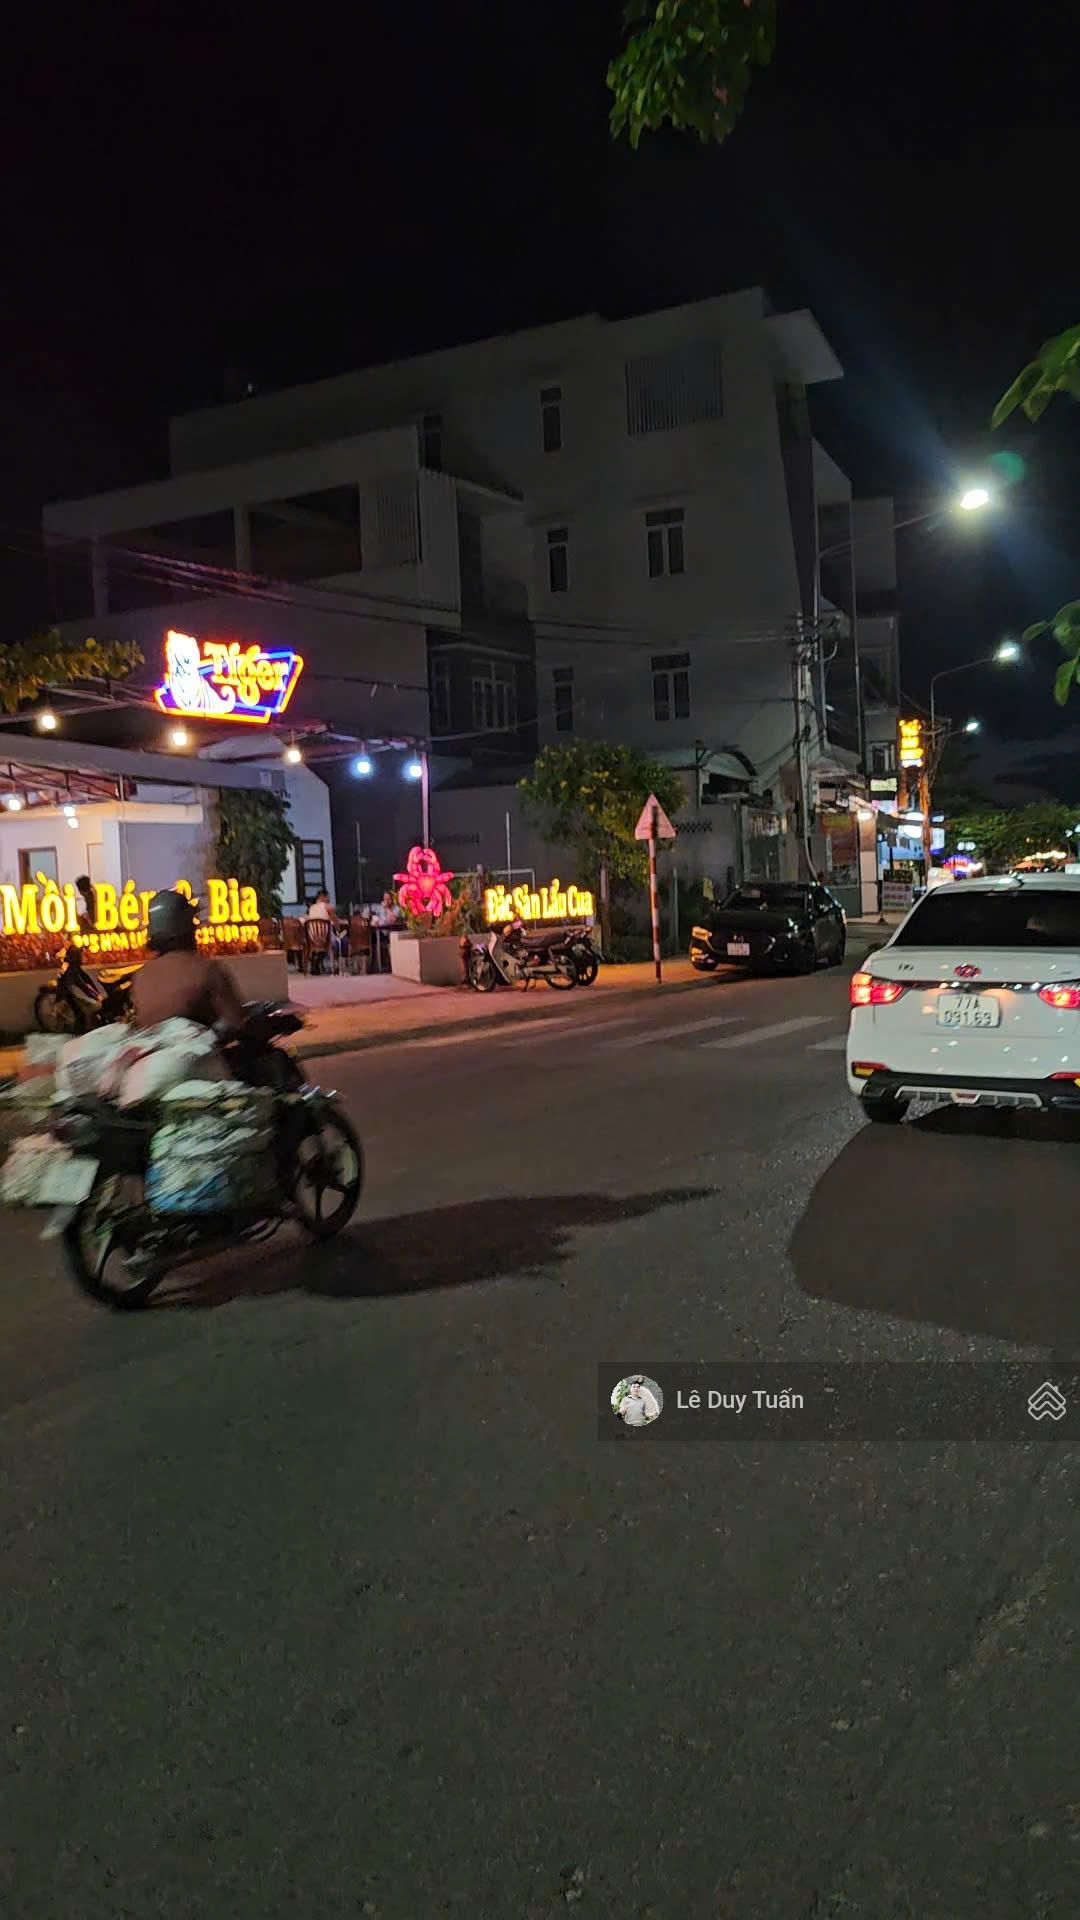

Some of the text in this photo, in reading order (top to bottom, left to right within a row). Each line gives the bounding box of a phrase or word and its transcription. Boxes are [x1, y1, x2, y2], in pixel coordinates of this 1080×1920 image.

[203, 641, 288, 706] Tiger
[0, 871, 81, 936] Mồi
[207, 877, 260, 924] Bia
[567, 885, 593, 917] Cua
